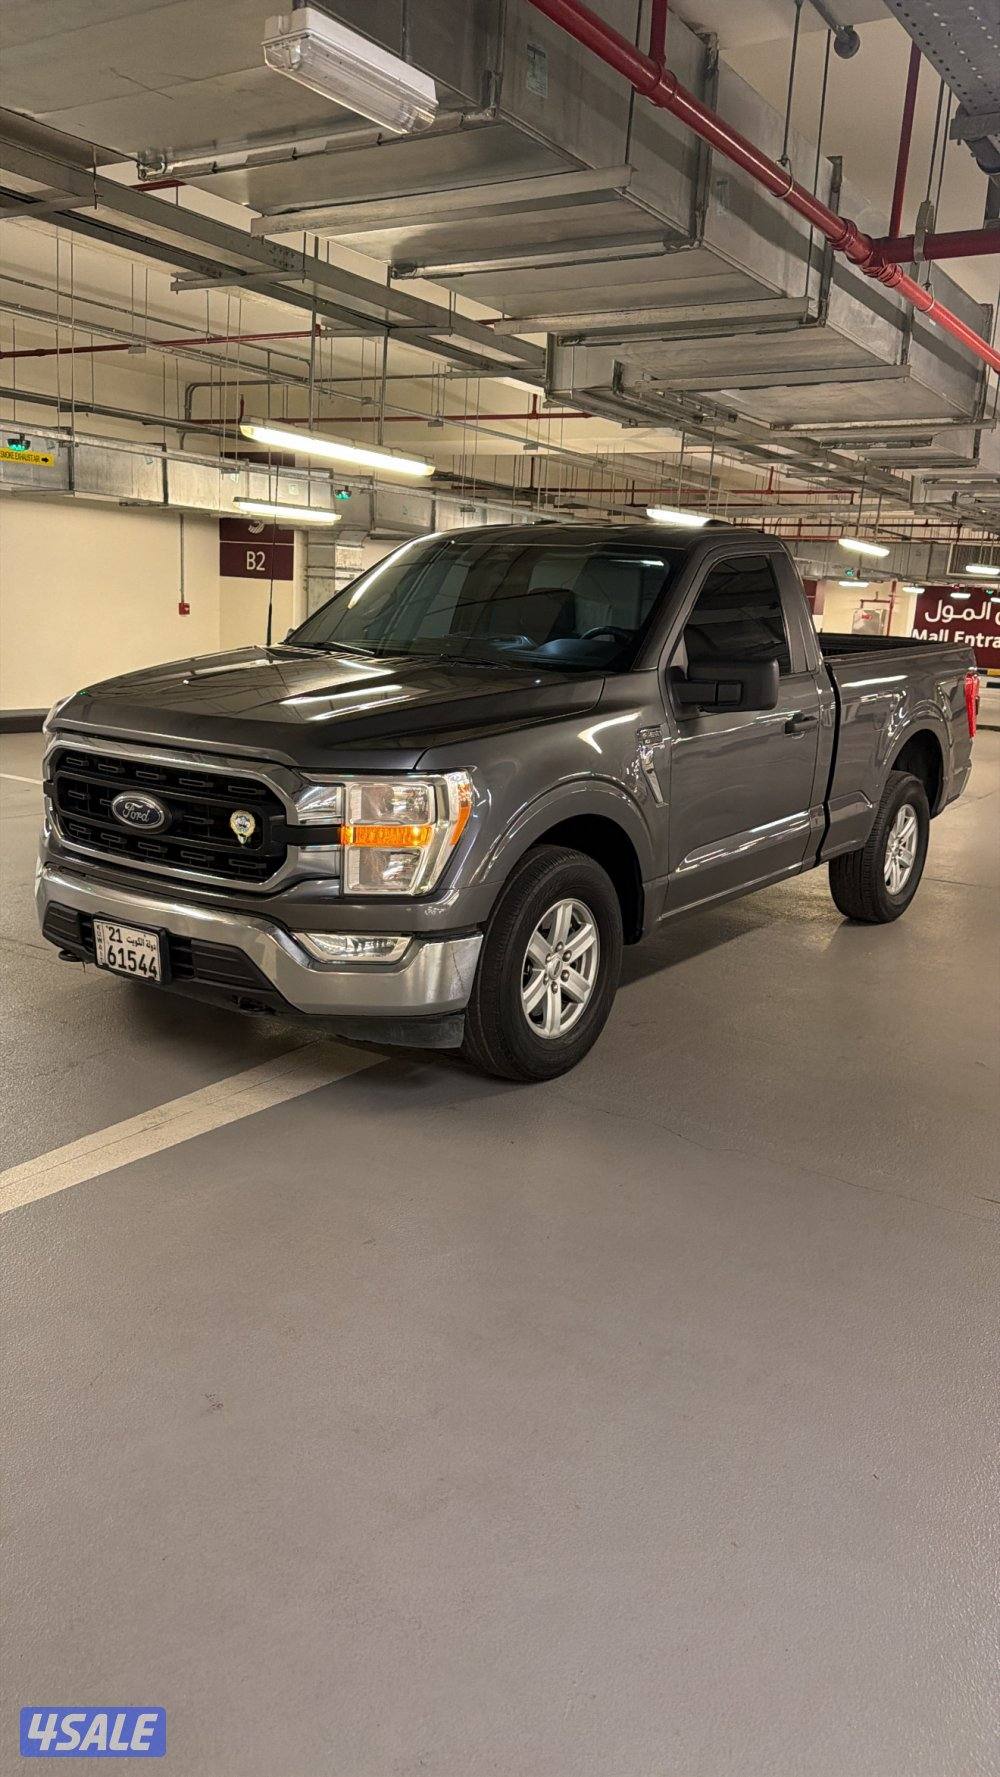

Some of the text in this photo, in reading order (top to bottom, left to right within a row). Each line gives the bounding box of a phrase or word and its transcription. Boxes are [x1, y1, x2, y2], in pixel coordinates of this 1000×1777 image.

[246, 550, 266, 571] B2
[912, 628, 950, 643] Mall
[122, 801, 151, 822] Ford
[108, 926, 123, 944] 21
[107, 945, 158, 978] 61544
